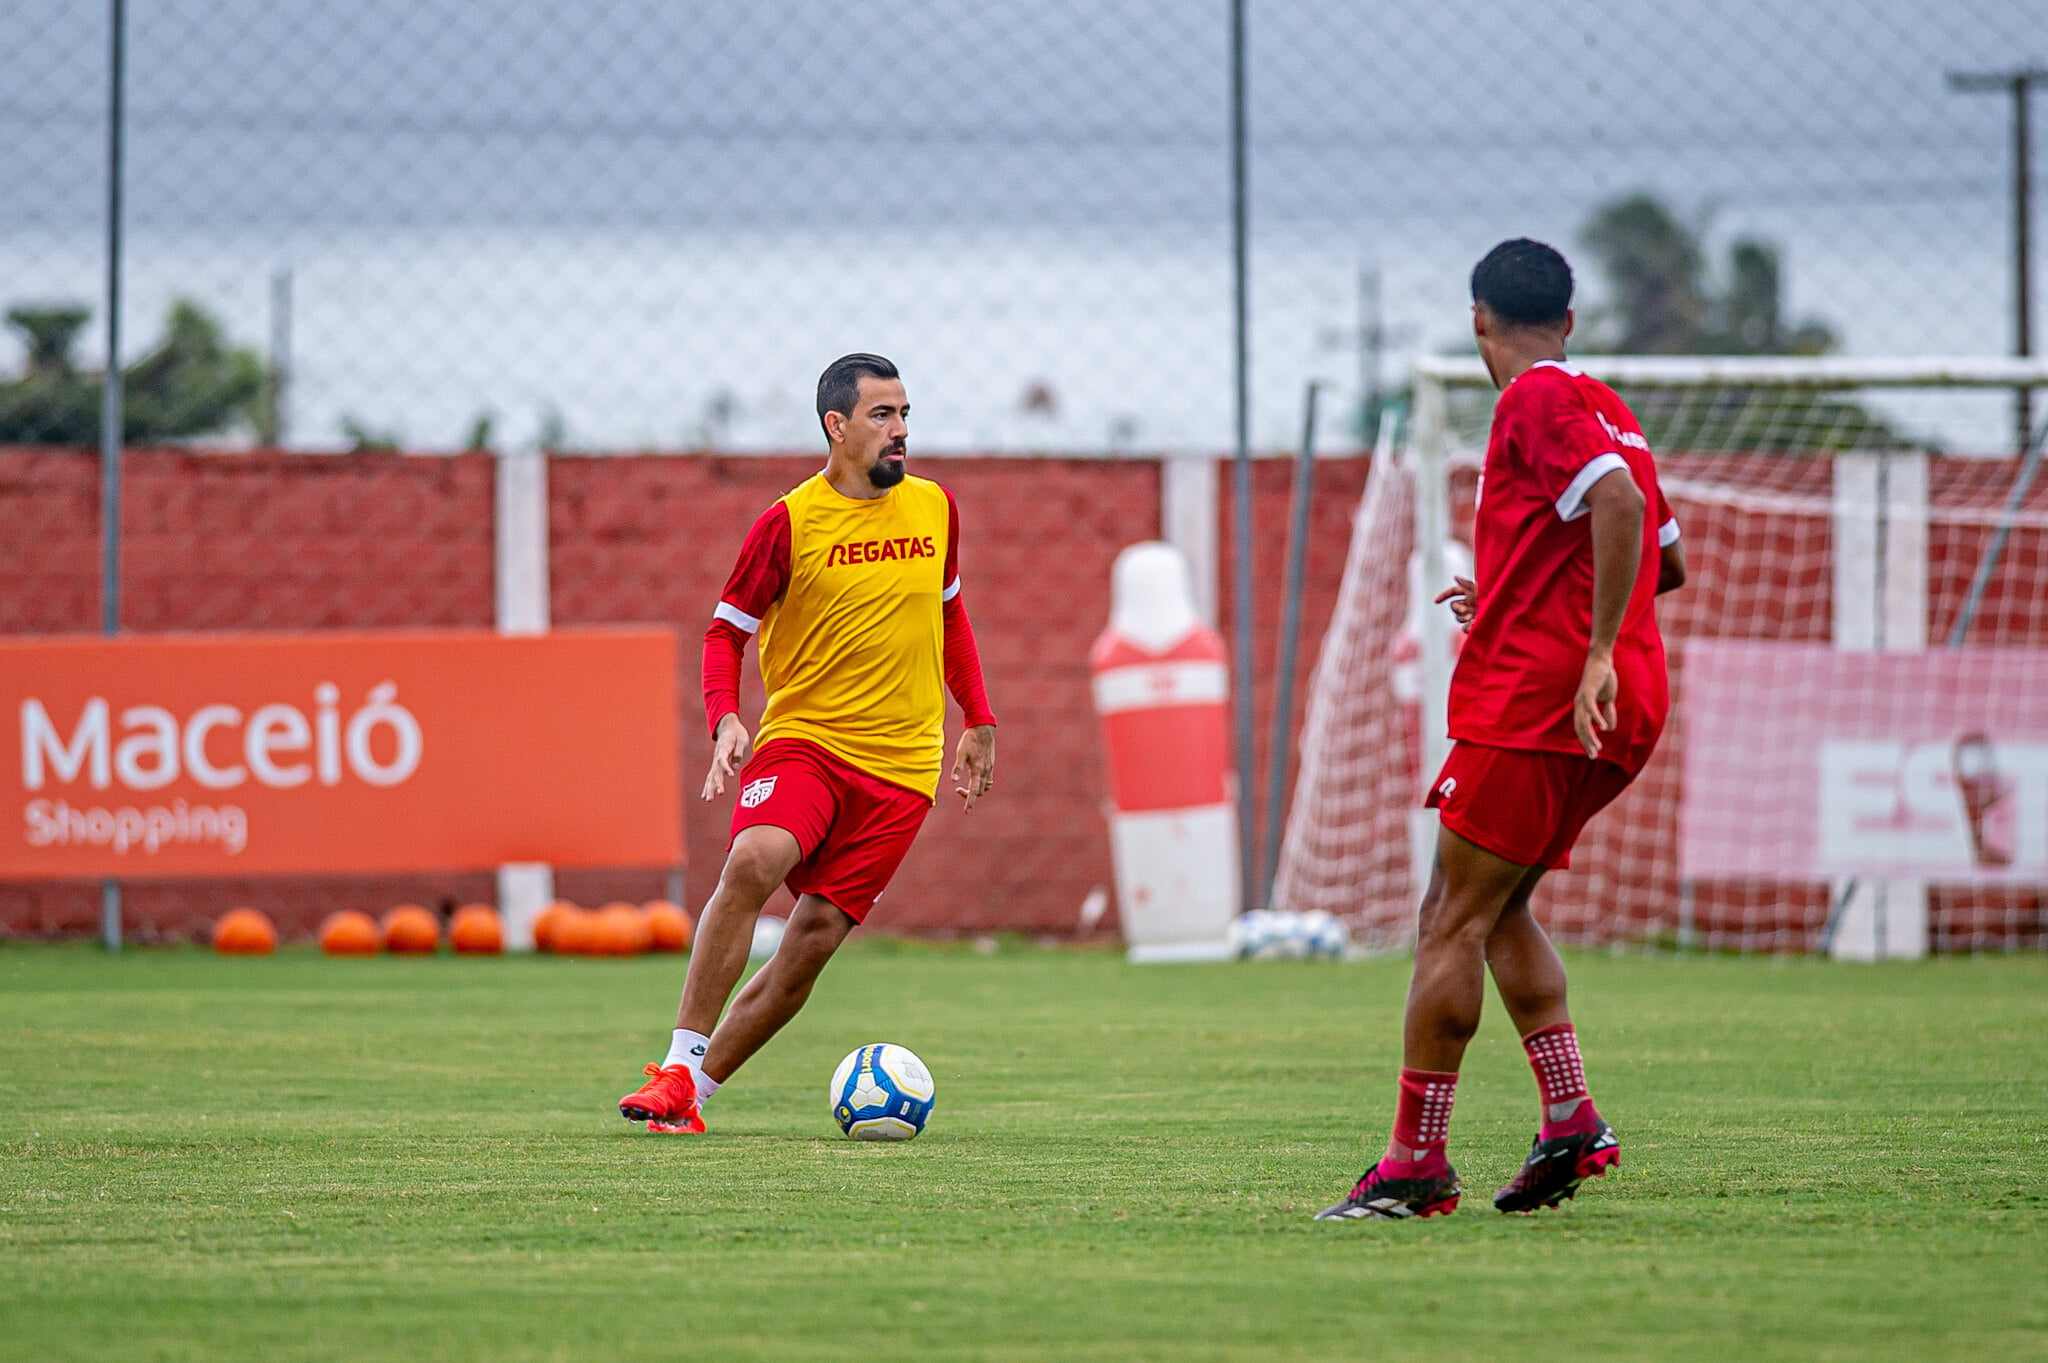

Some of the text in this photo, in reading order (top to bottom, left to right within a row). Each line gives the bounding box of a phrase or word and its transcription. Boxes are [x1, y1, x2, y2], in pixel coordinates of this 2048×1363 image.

[826, 536, 936, 568] REGATAS
[20, 681, 424, 791] Maceió
[24, 797, 248, 856] Shopping
